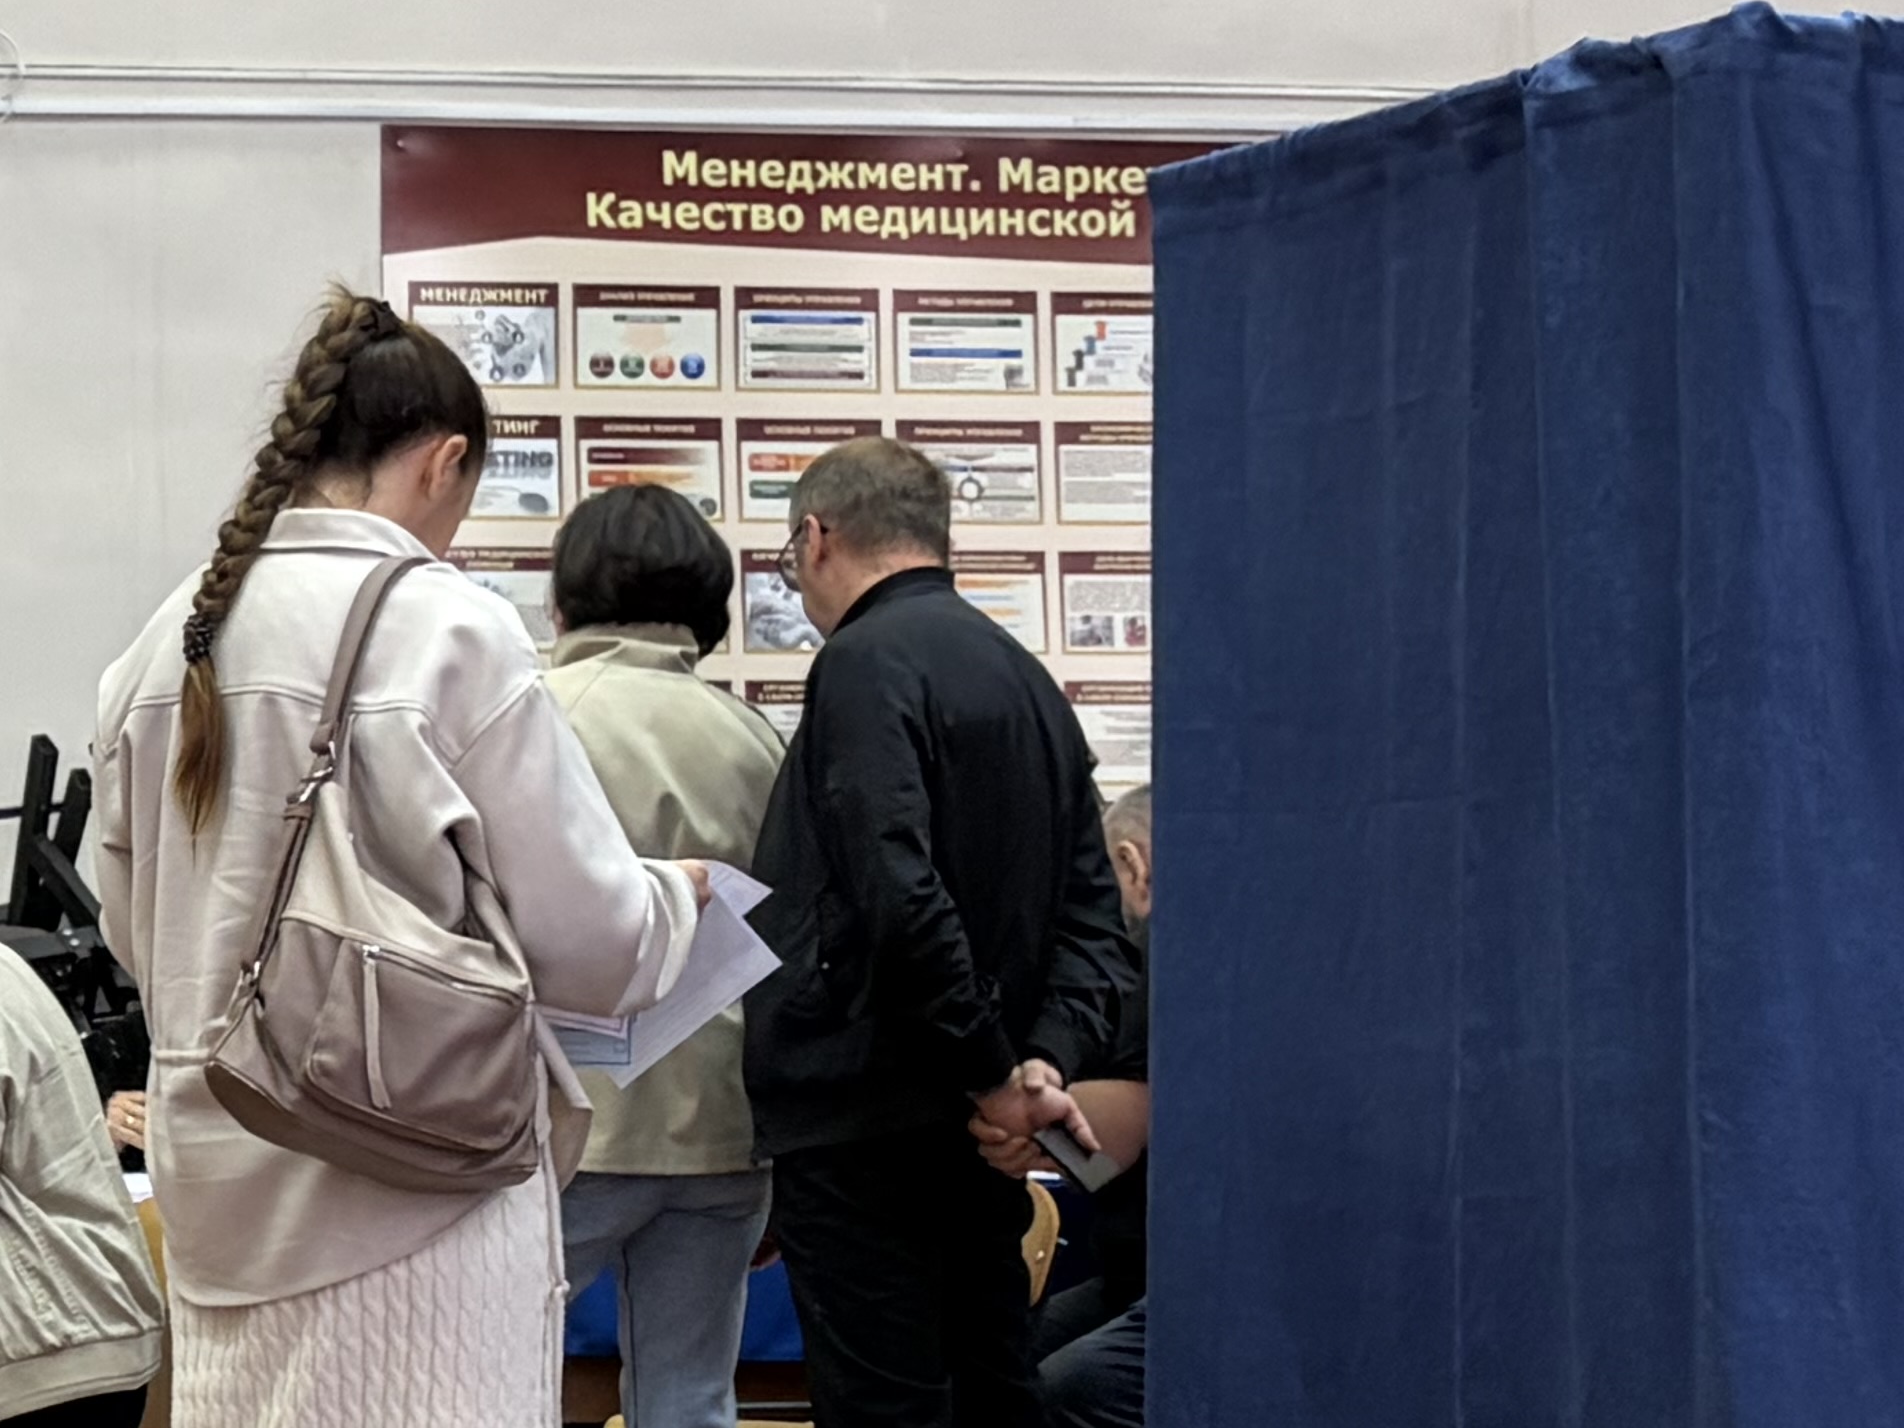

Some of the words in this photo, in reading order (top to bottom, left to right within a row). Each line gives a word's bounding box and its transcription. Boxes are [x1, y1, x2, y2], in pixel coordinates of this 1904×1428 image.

[662, 150, 980, 194] Менеджмент.
[999, 157, 1148, 202] Марке
[586, 192, 804, 232] Качество
[821, 199, 1135, 241] медицинской
[419, 286, 549, 305] МЕНЕДЖМЕНТ
